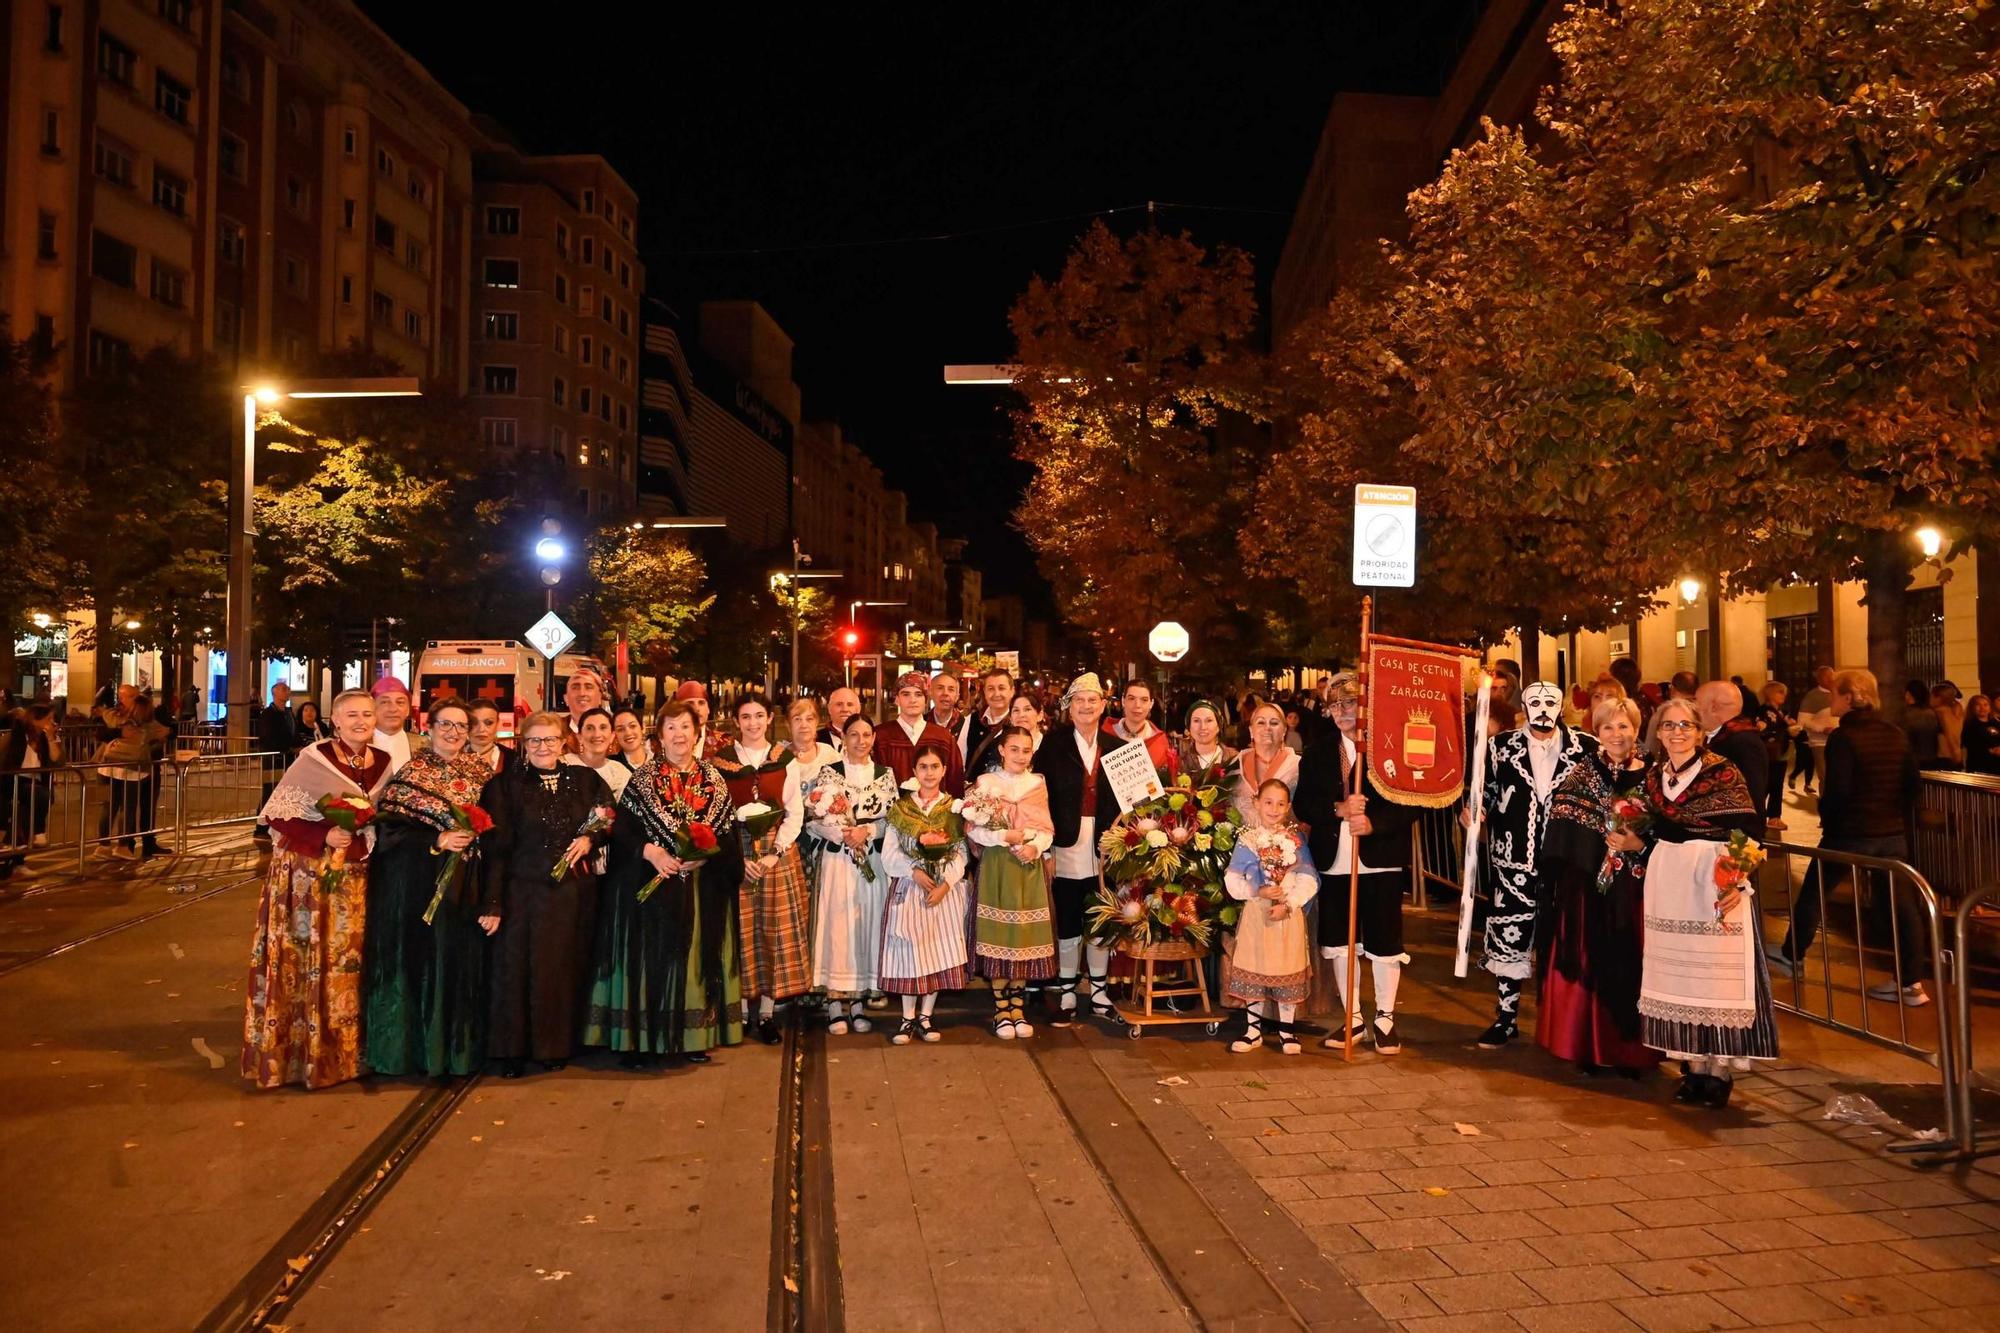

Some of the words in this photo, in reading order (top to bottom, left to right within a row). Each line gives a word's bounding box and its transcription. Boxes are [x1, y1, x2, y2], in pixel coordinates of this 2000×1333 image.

[1360, 560, 1408, 569] PRIORIDAD
[1360, 571, 1406, 581] PEATONAL
[541, 627, 562, 643] 30
[432, 657, 506, 667] AMBULANCIA
[1379, 657, 1404, 671] CASA
[1408, 662, 1419, 673] DE
[1422, 663, 1455, 679] CETINA
[1412, 675, 1424, 686] EN
[1390, 685, 1447, 702] ZARAGOZA
[1110, 751, 1143, 771] CULTURAL
[1111, 765, 1135, 780] CASA
